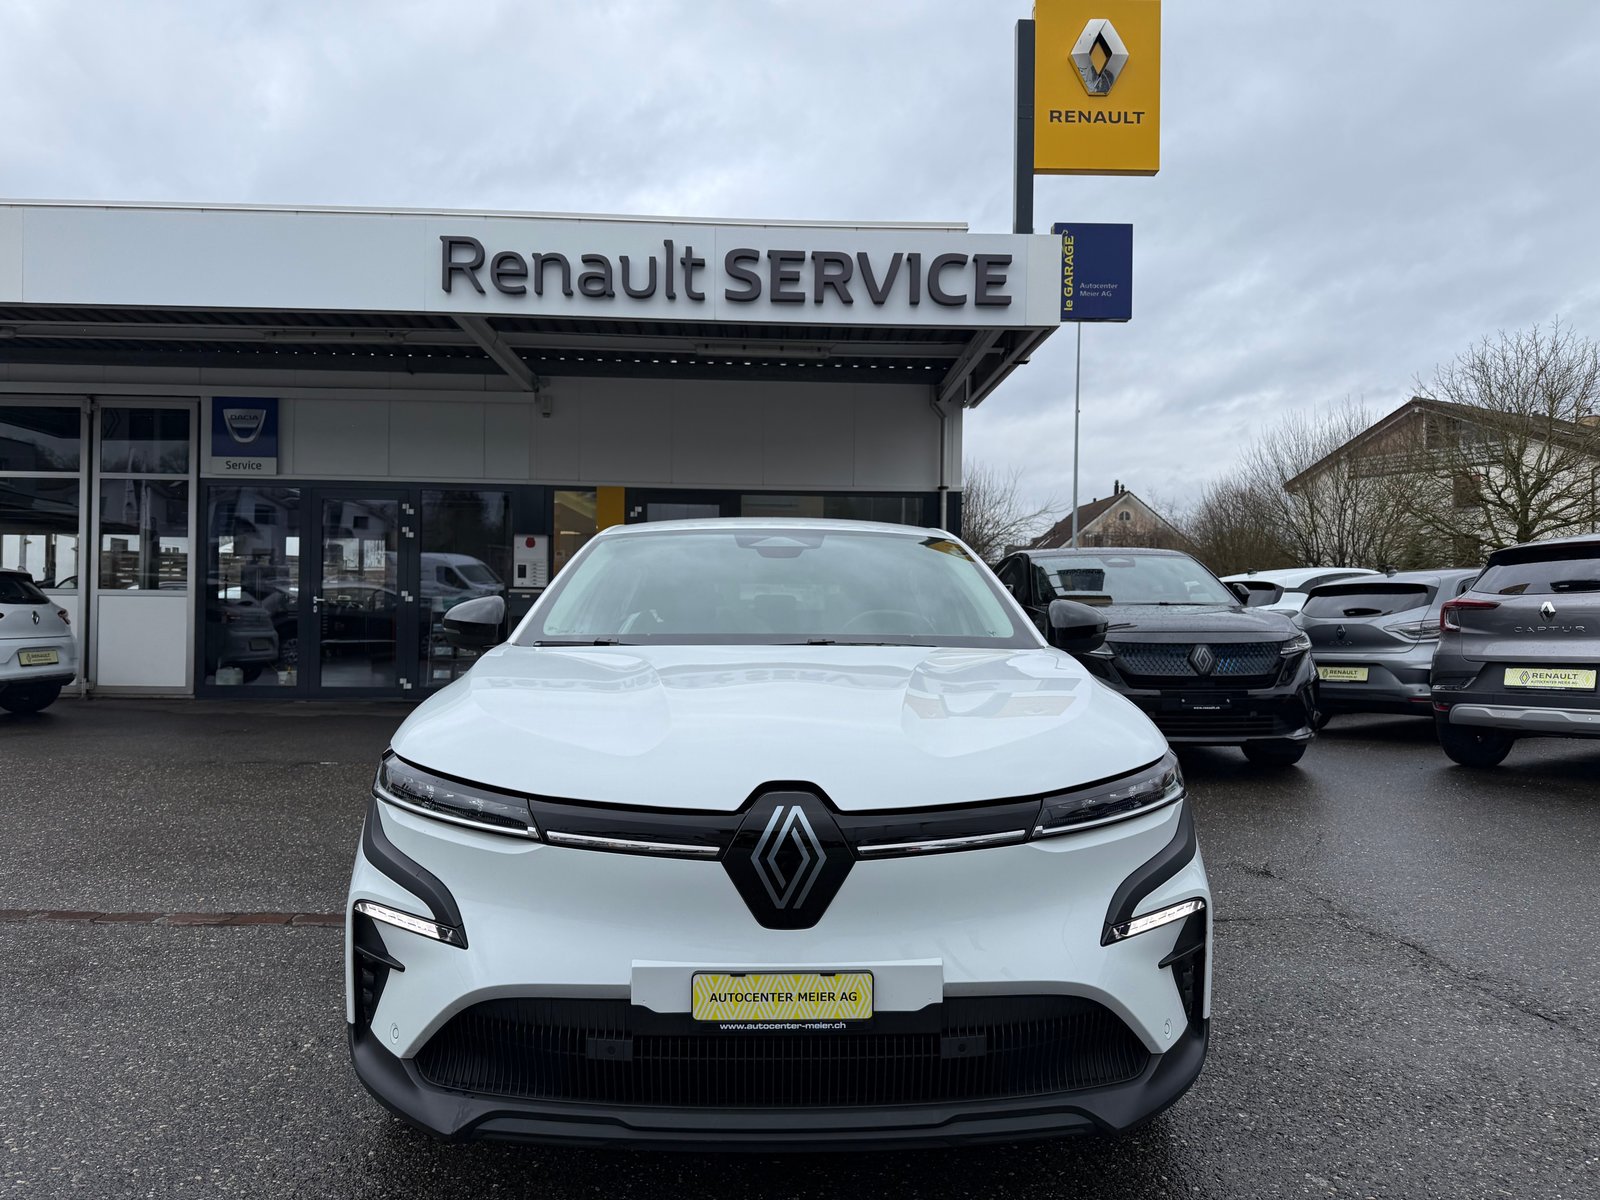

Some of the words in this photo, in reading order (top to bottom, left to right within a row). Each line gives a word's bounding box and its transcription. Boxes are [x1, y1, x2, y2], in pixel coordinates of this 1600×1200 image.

[1050, 110, 1145, 125] RENAULT
[439, 235, 705, 301] Renault
[724, 247, 1013, 307] SERVICE
[1063, 235, 1075, 297] GARAGE
[1079, 282, 1118, 290] Autocenter
[1101, 290, 1112, 298] AG
[1063, 299, 1073, 311] le
[225, 460, 262, 470] Service
[1513, 625, 1586, 633] CAPTUR
[1531, 672, 1579, 680] RENAULT
[709, 992, 794, 1003] AUTOCENTER
[797, 991, 836, 1002] MEIER
[839, 991, 858, 1002] AG
[719, 1021, 847, 1031] www.autocenter-meier.ch
